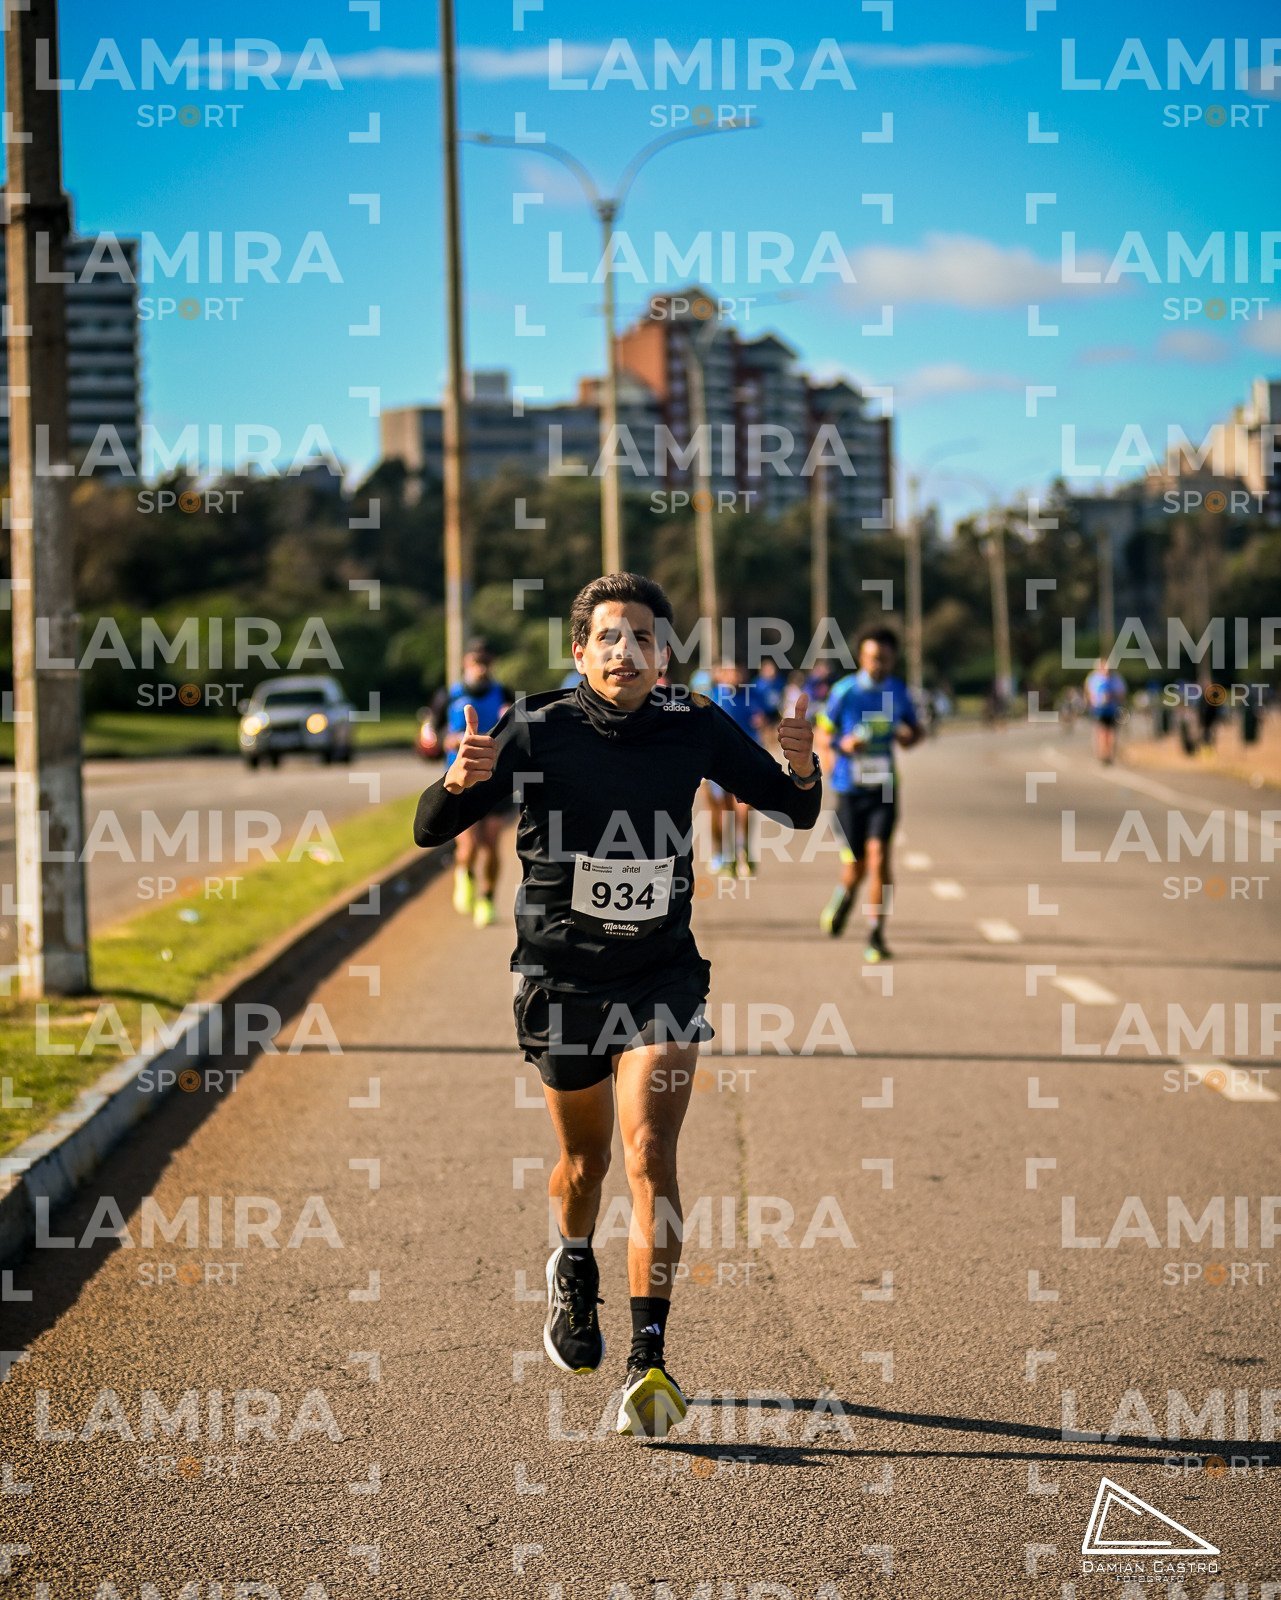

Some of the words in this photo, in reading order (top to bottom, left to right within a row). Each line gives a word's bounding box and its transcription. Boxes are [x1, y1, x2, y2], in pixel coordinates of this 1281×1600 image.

[663, 704, 690, 712] adidas
[622, 866, 641, 874] antel
[591, 882, 655, 910] 934
